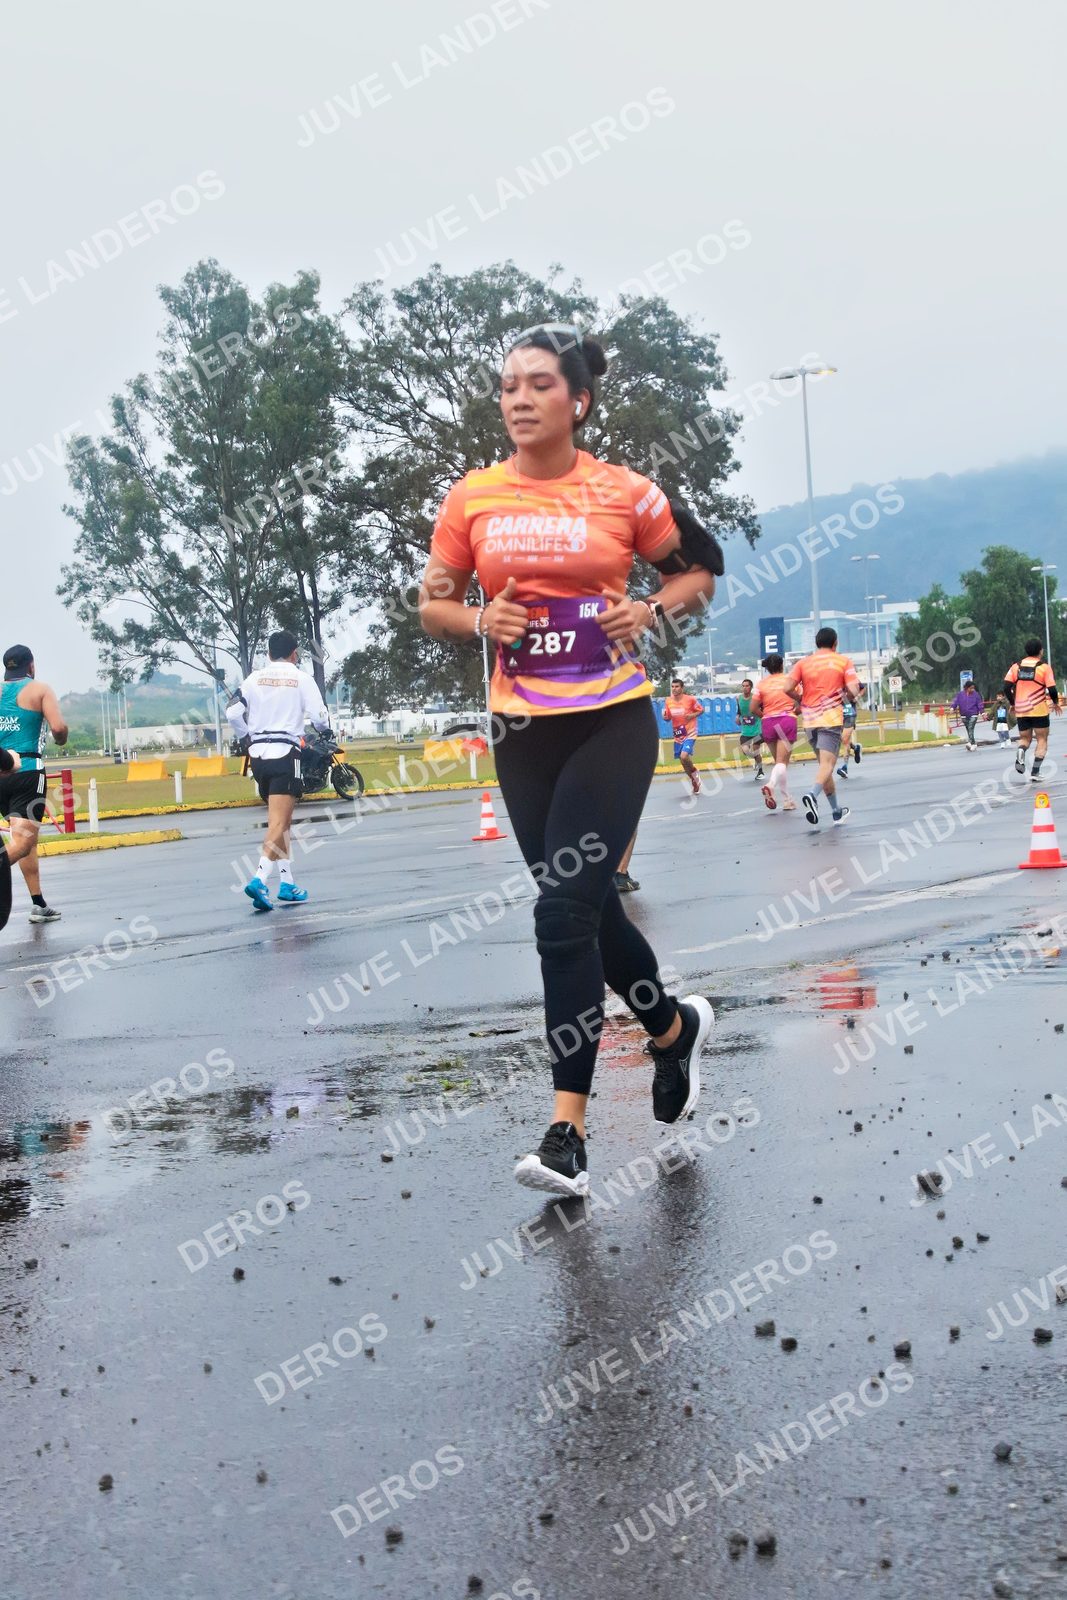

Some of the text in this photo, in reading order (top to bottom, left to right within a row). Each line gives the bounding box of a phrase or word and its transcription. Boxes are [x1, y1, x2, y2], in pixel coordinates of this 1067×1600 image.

[486, 515, 587, 537] CARRERA
[485, 537, 563, 553] OMNILIFE
[579, 603, 599, 618] 15K
[528, 631, 576, 655] 287
[765, 635, 778, 653] E
